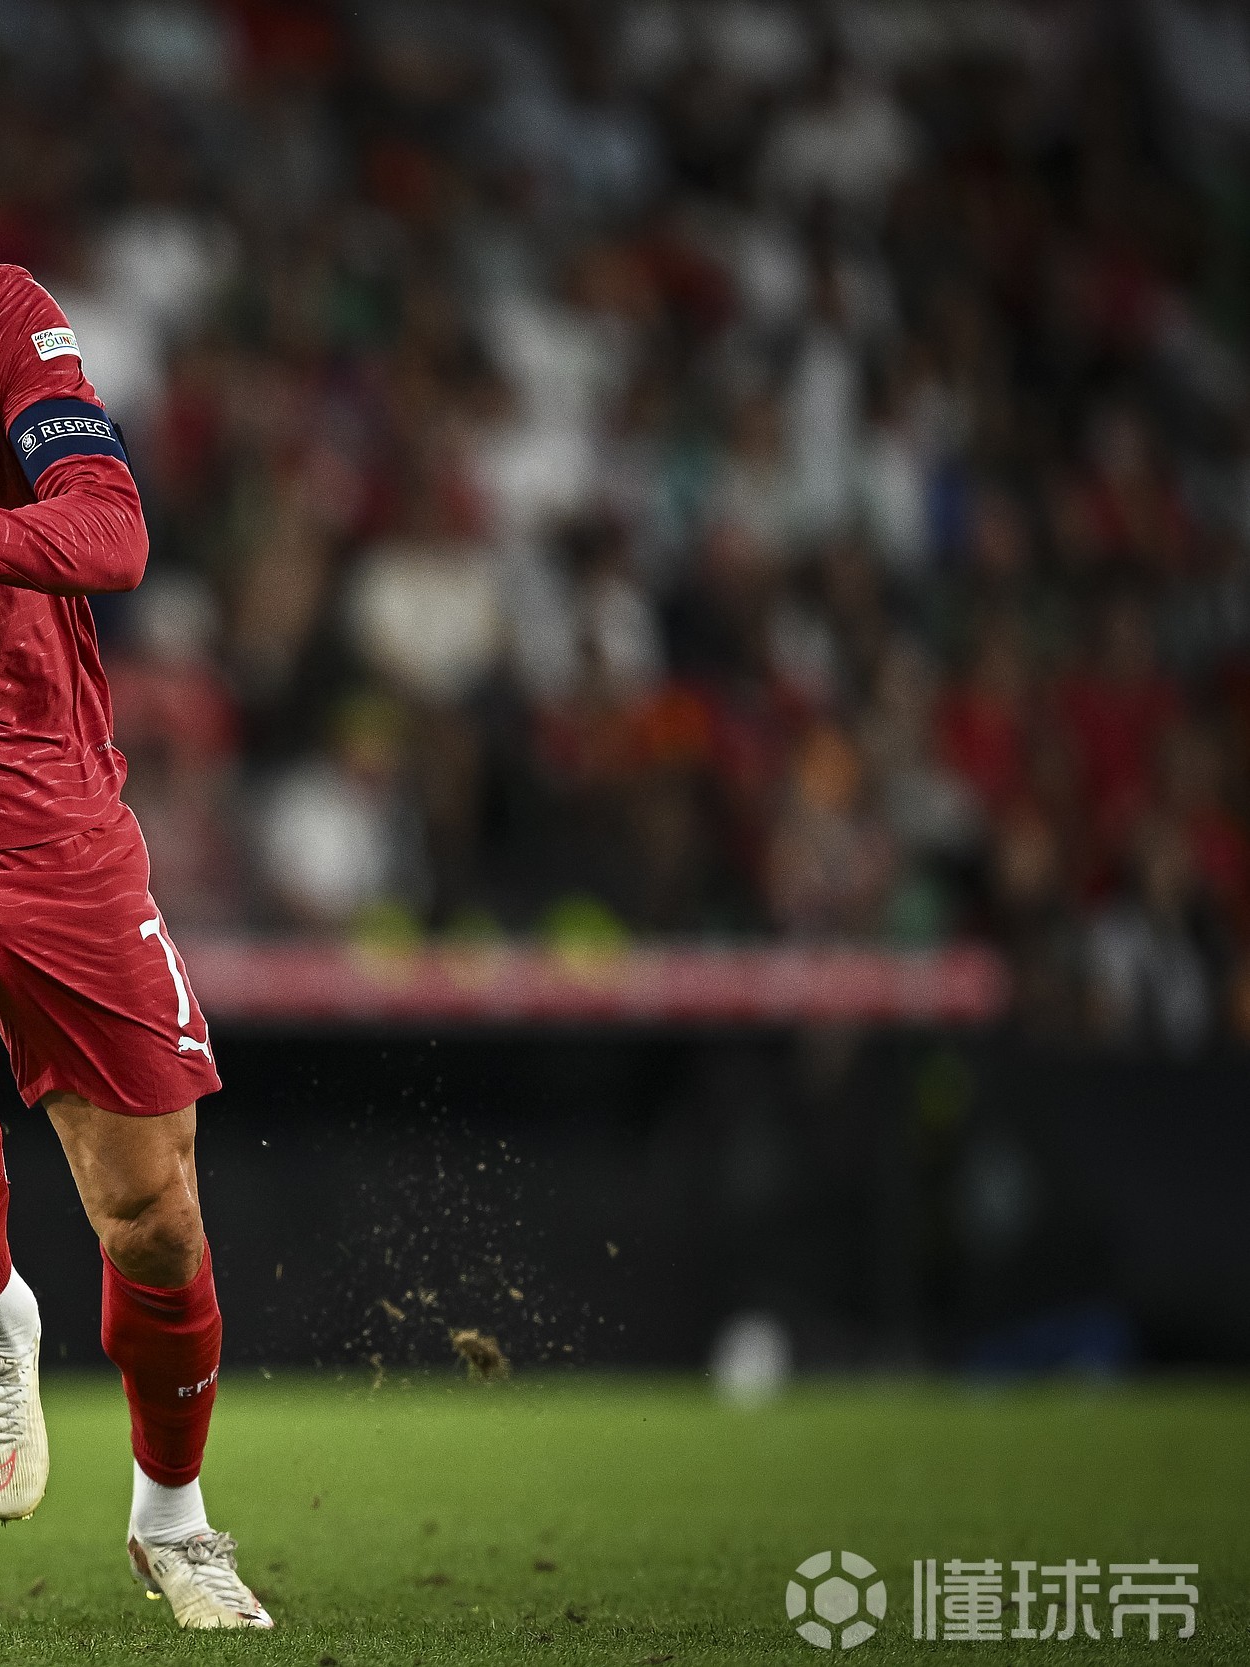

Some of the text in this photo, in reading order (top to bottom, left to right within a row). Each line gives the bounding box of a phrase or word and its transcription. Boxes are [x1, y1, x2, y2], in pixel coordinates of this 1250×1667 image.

[34, 331, 54, 342] UEFA
[40, 419, 112, 439] RESPECT
[139, 913, 191, 1028] 7
